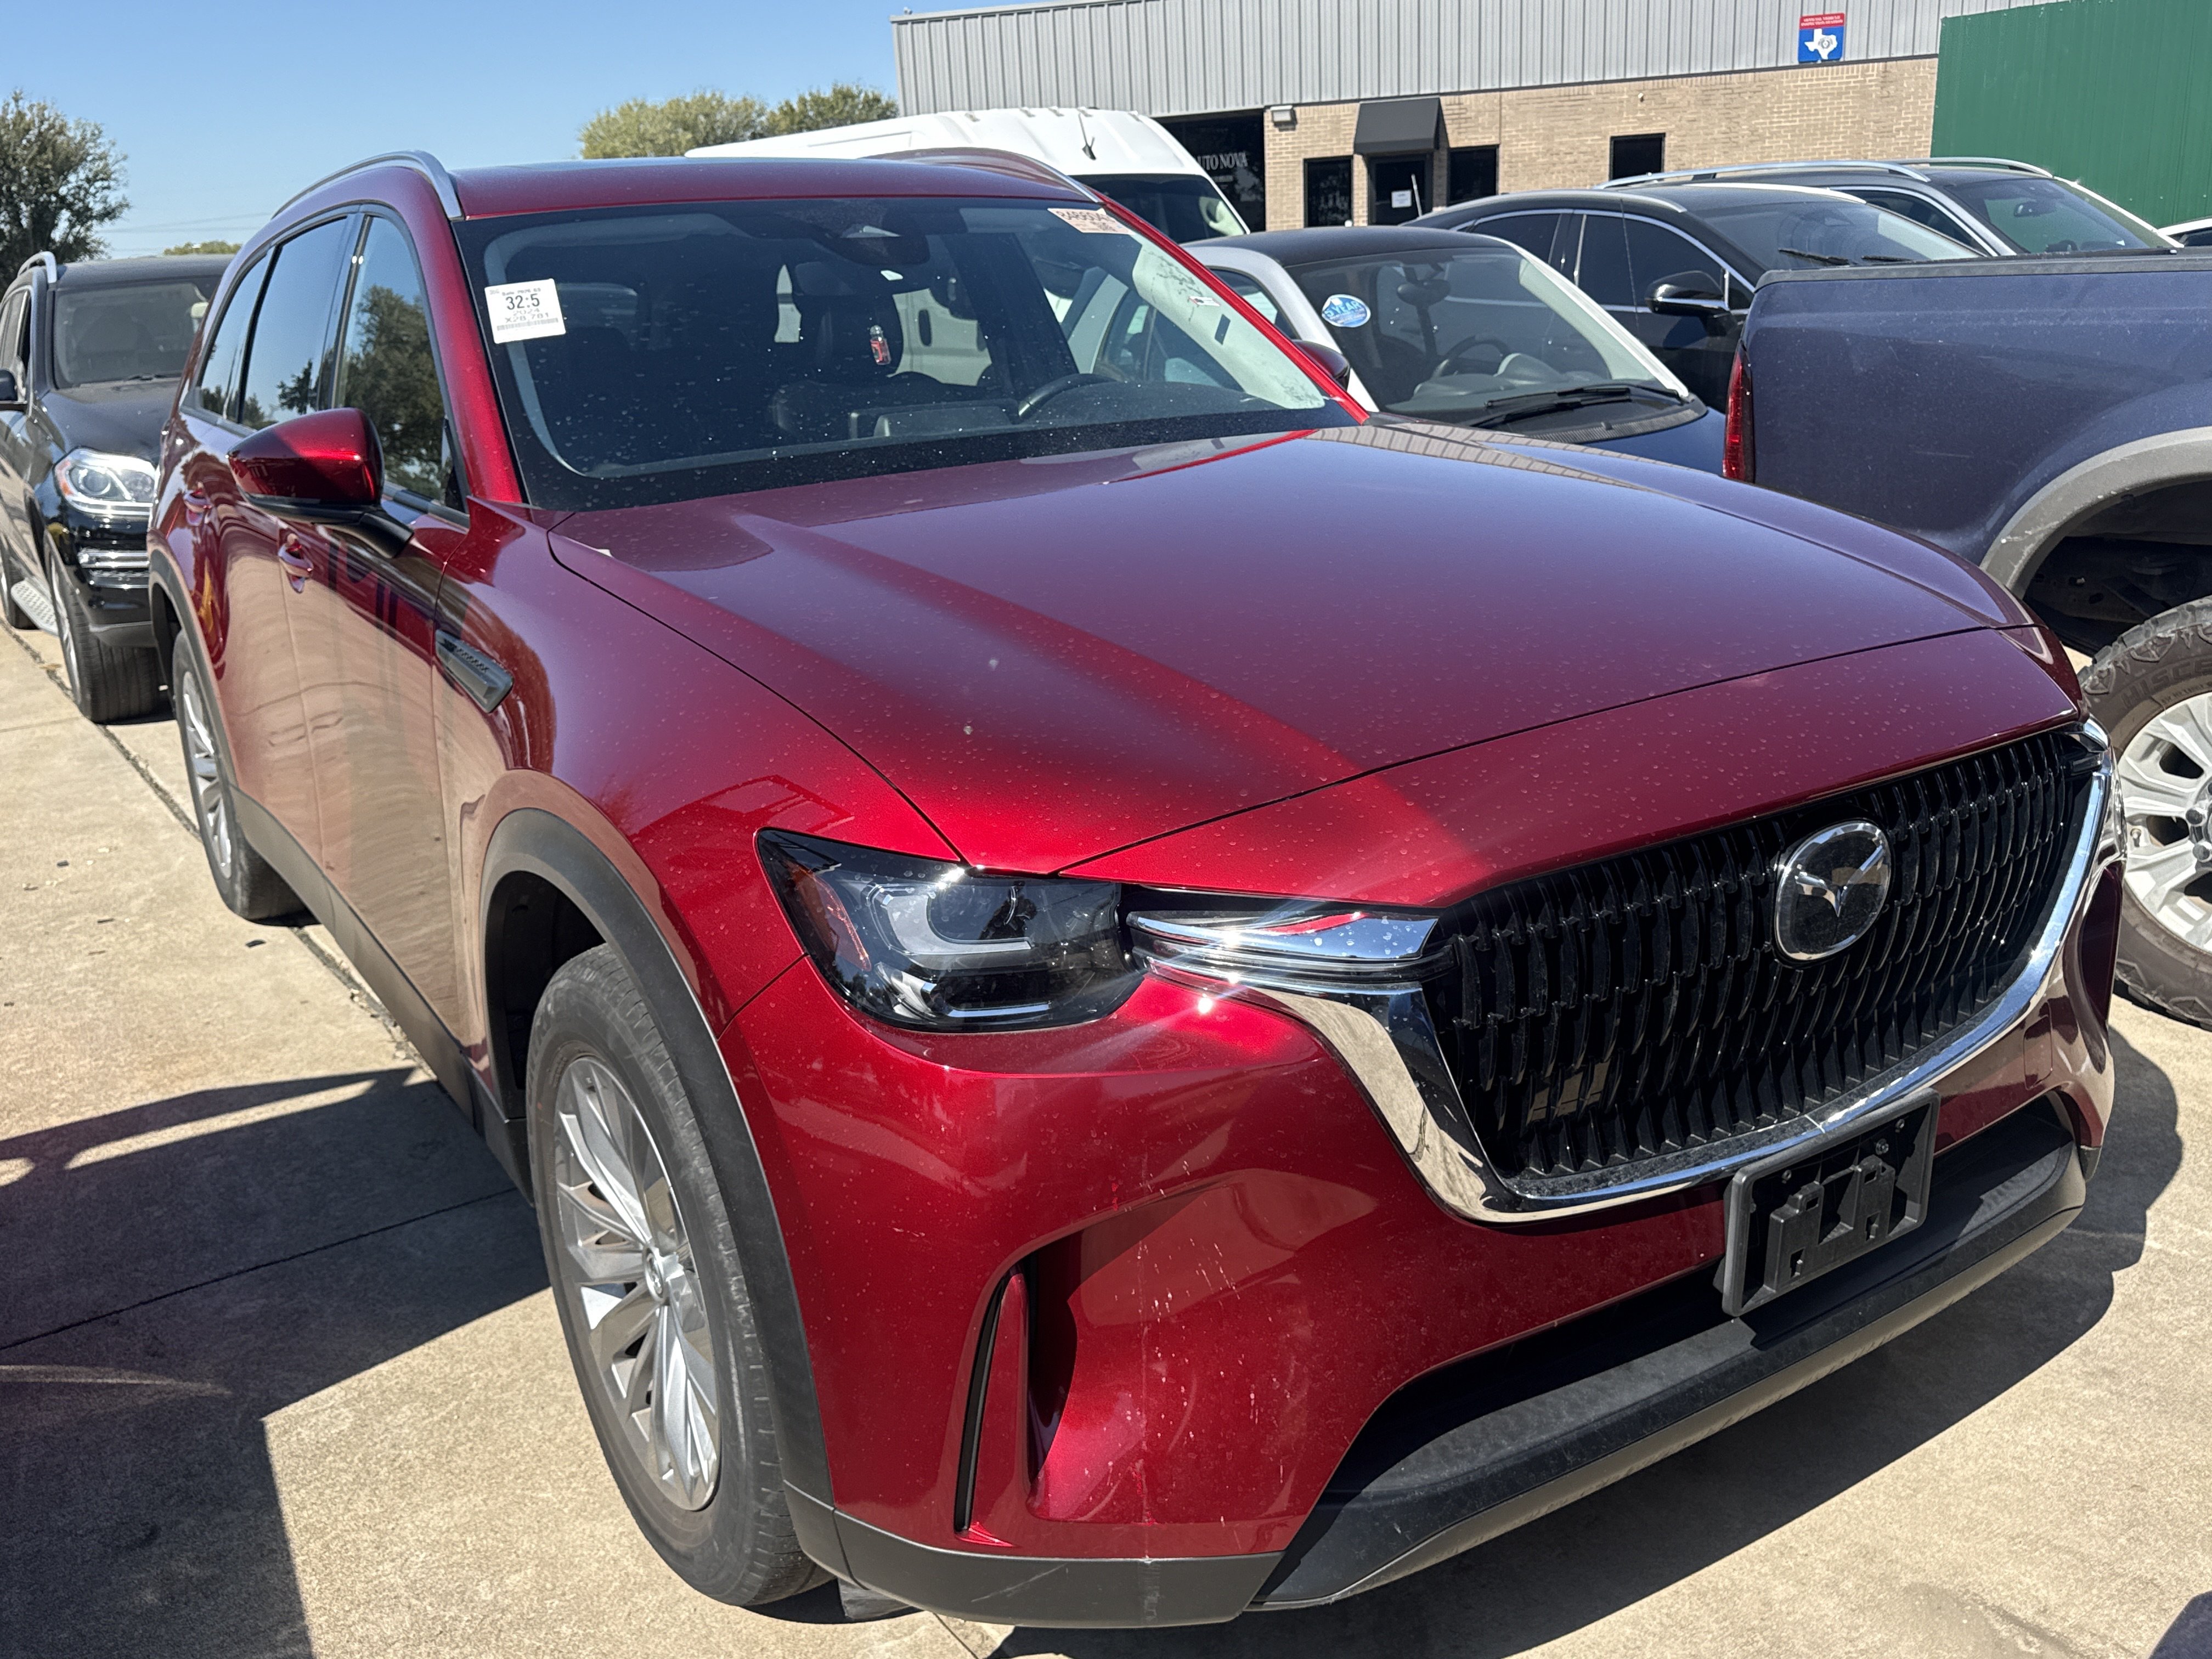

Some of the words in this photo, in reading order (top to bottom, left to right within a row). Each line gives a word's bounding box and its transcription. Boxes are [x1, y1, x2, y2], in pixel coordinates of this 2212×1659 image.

[1196, 154, 1219, 170] UTO
[1220, 151, 1248, 169] NOVA
[506, 294, 540, 310] 32:5
[1331, 301, 1362, 314] YEAR
